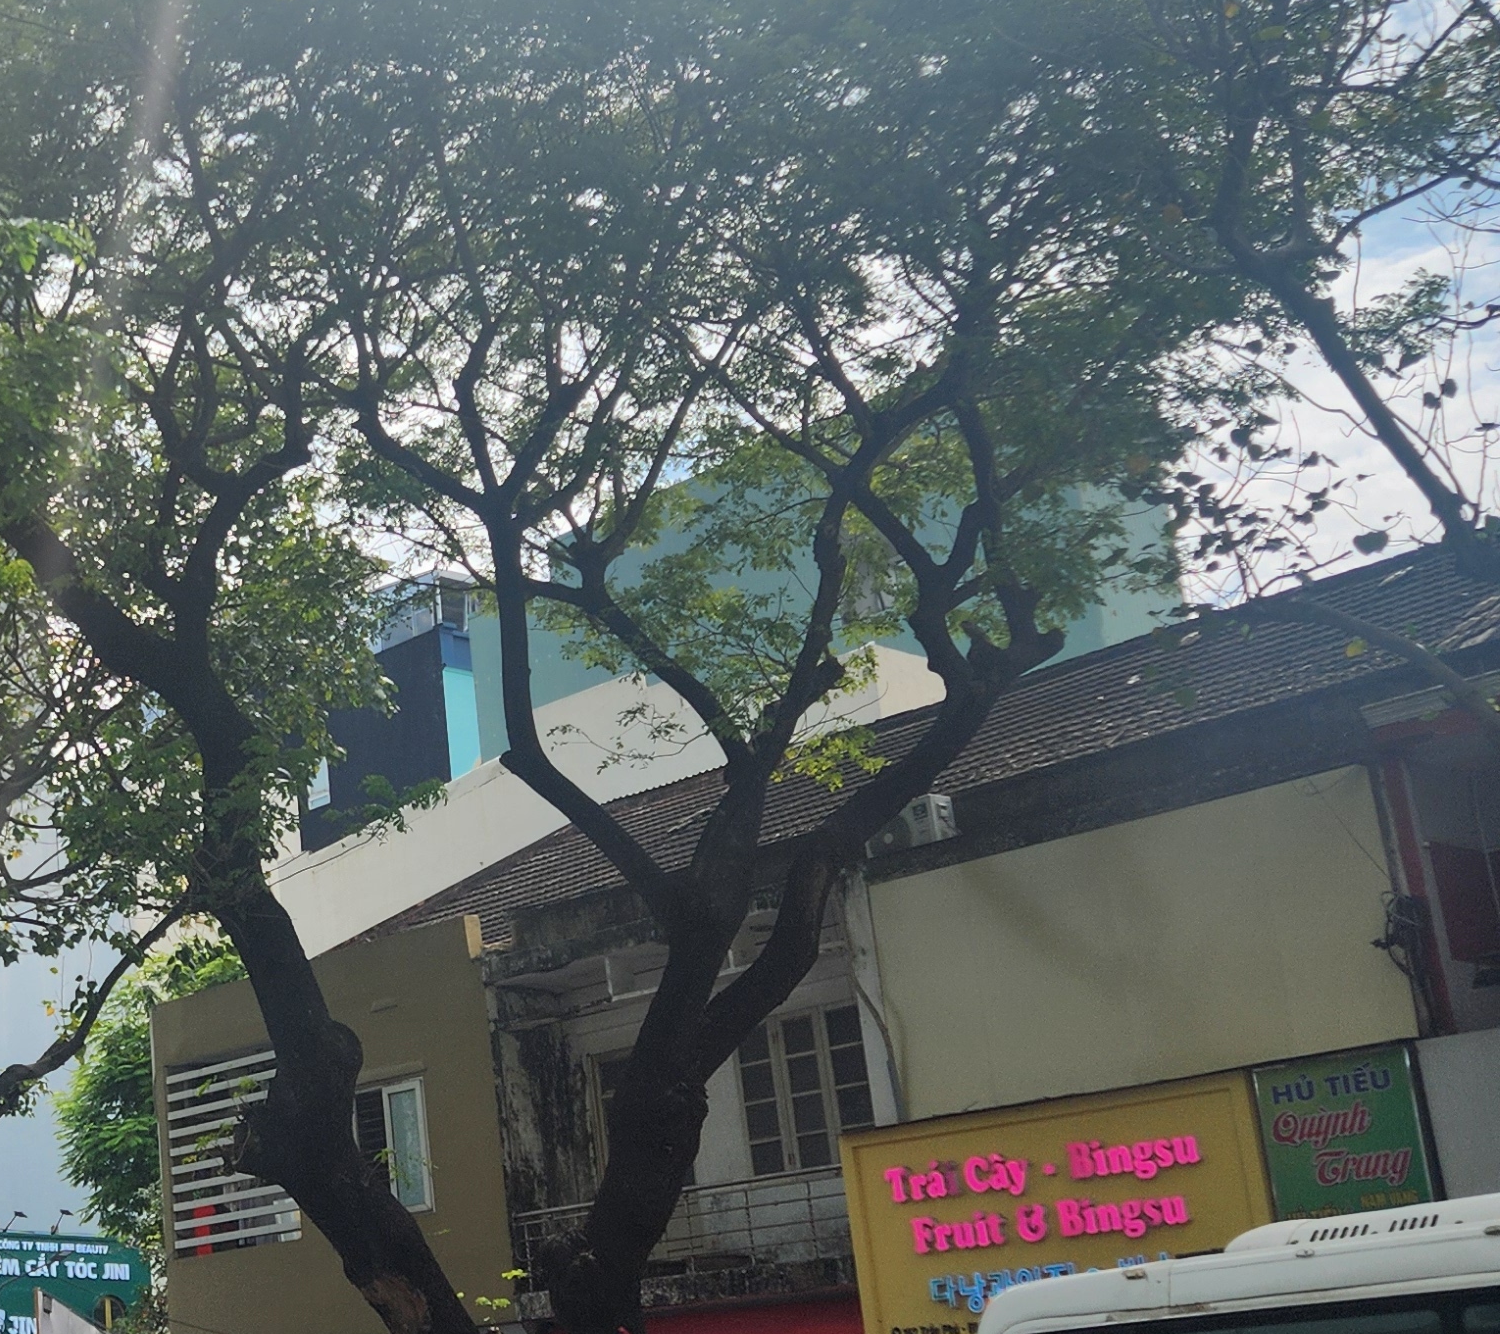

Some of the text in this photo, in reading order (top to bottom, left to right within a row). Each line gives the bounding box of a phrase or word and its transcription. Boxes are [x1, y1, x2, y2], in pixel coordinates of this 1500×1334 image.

[1271, 1074, 1316, 1105] HỦ
[1272, 1099, 1372, 1150] Quỳnh
[884, 1161, 960, 1204] Trái
[963, 1153, 1029, 1197] Cây
[1066, 1134, 1202, 1180] Bingsu
[1313, 1147, 1413, 1187] Trang
[910, 1212, 1006, 1255] Fruit
[1055, 1195, 1191, 1238] Bingsu
[102, 1263, 131, 1281] JINI
